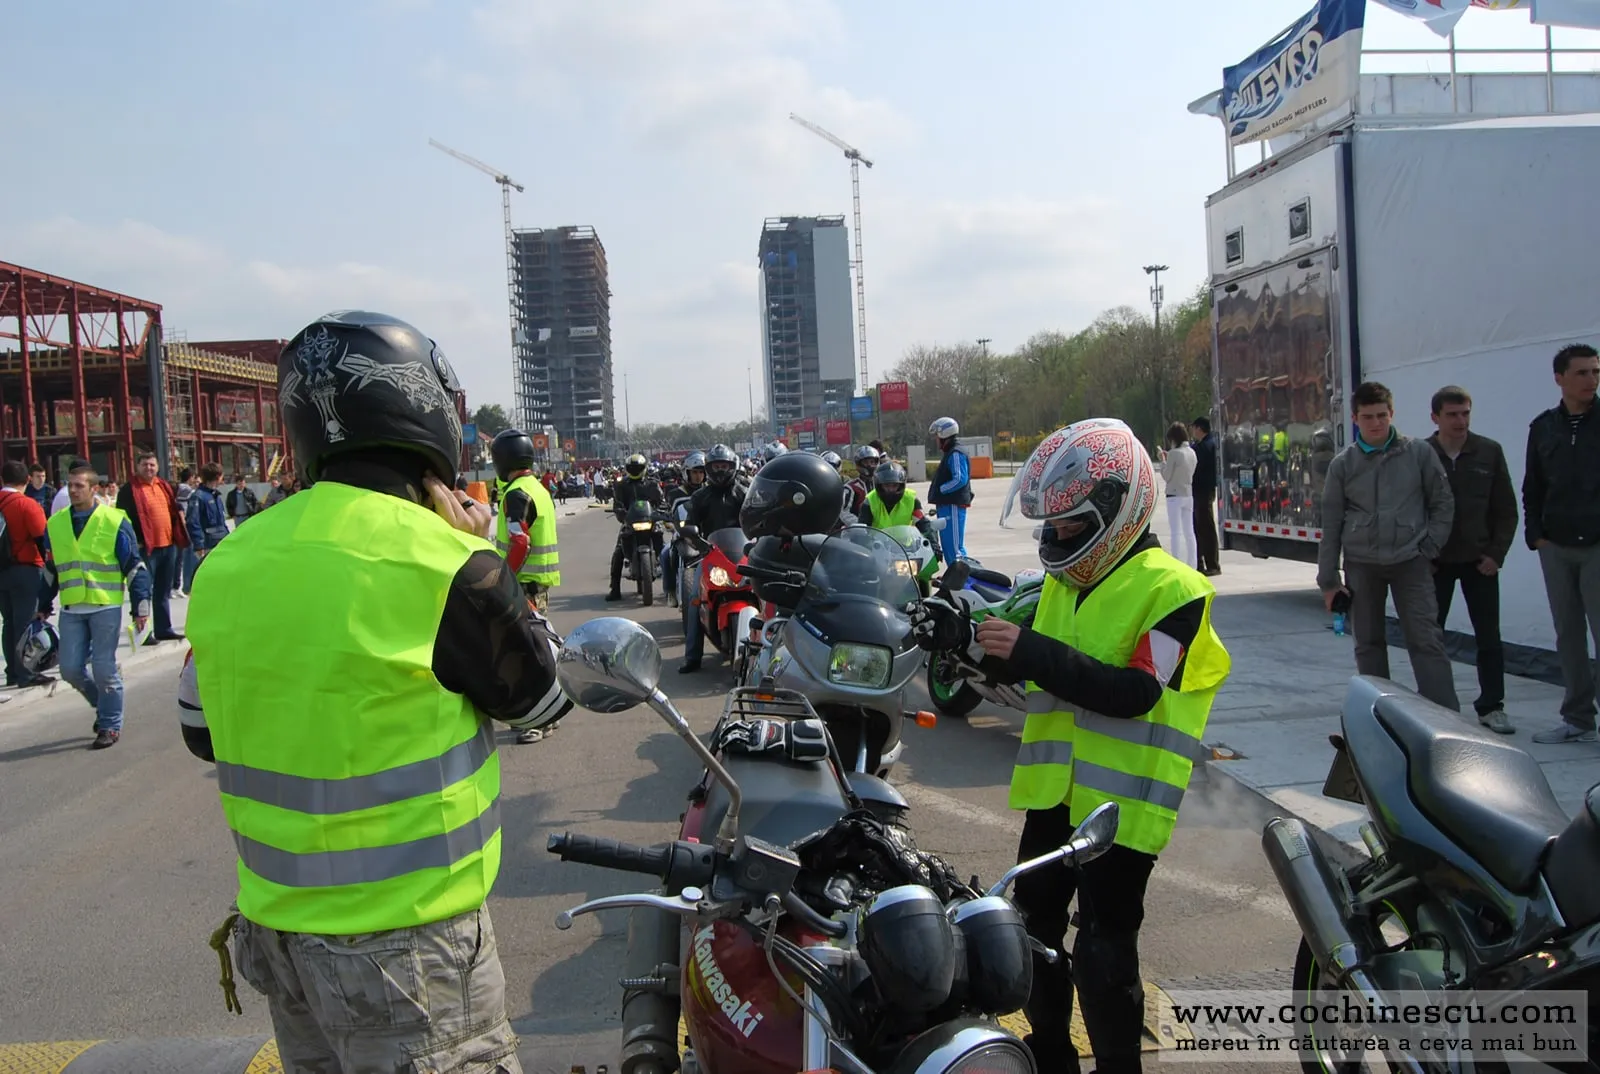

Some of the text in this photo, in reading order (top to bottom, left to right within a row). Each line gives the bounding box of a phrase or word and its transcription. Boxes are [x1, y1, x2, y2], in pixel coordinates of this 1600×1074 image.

[1271, 113, 1294, 129] RACING
[1294, 96, 1328, 118] MUFFLERS
[694, 923, 764, 1038] Kawasaki
